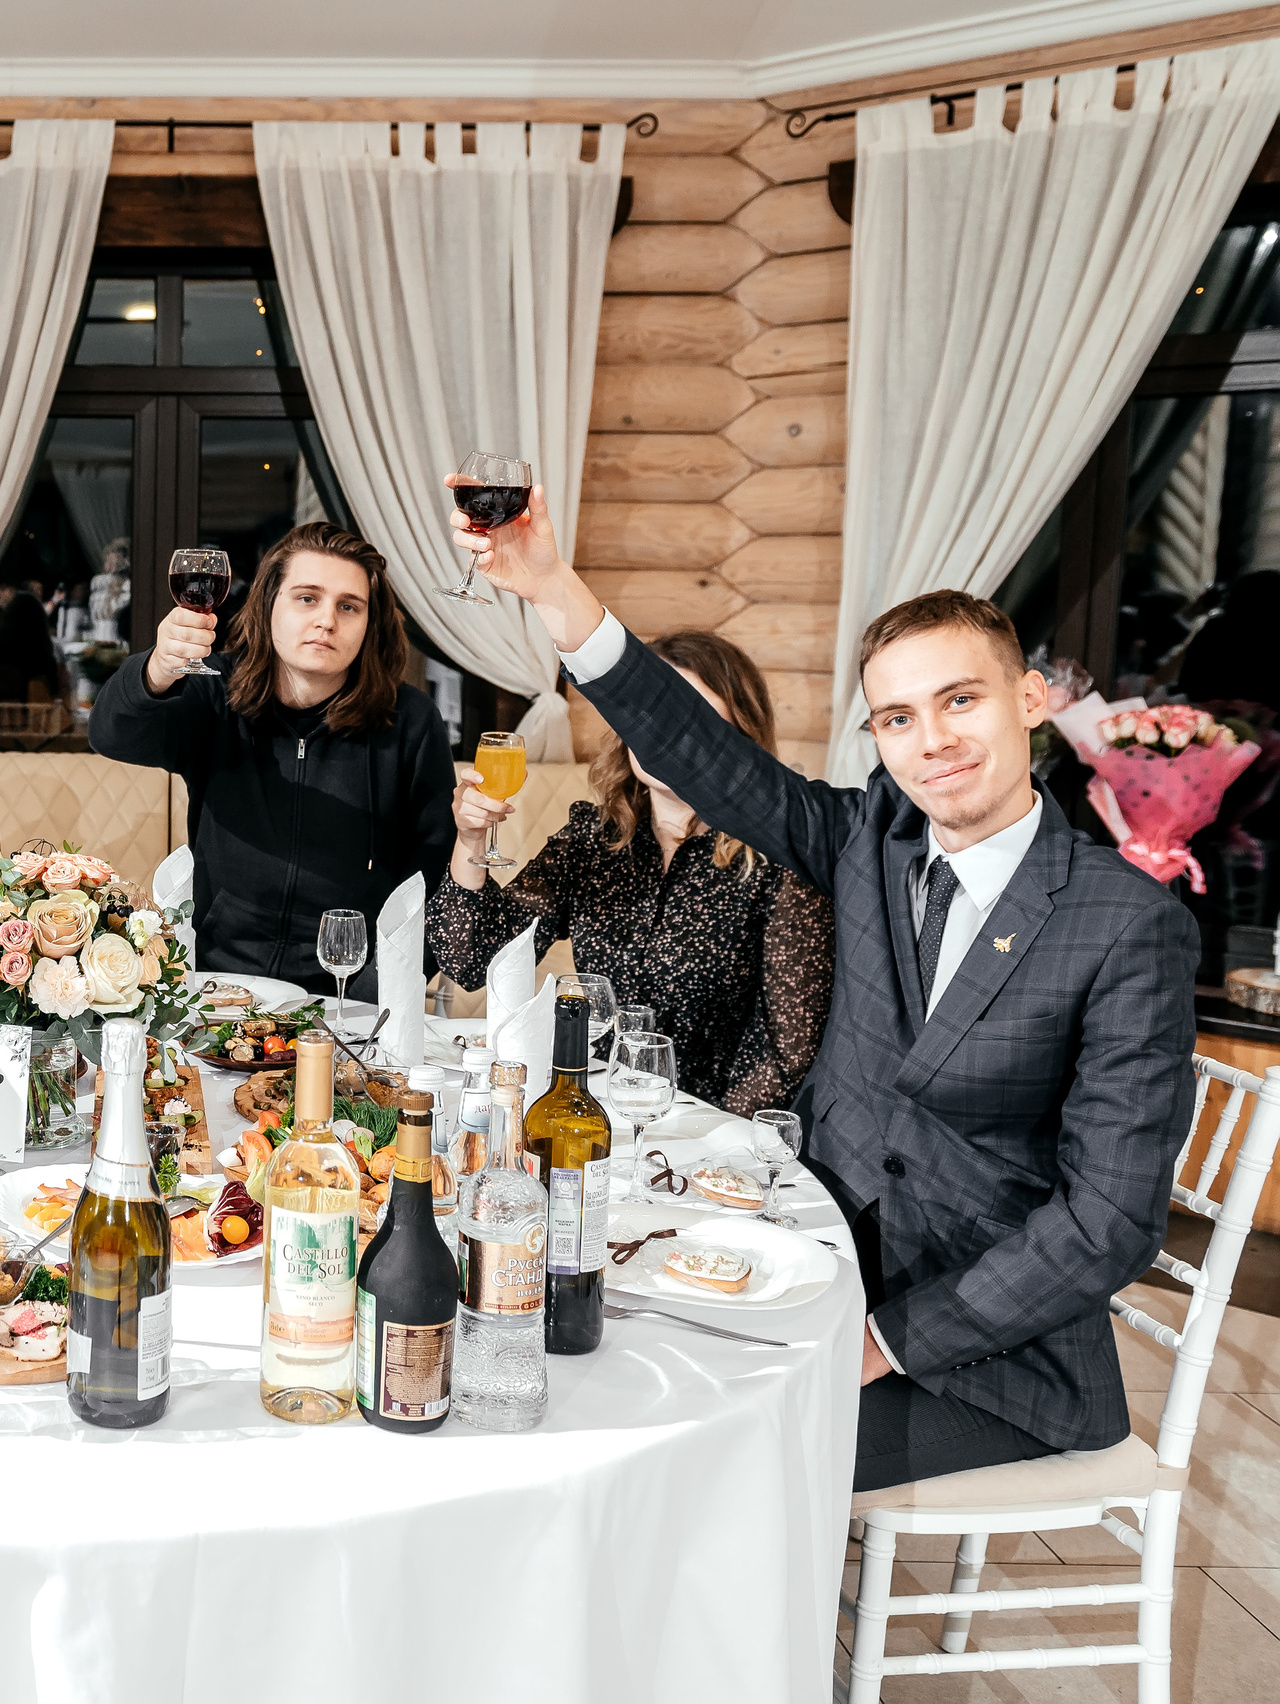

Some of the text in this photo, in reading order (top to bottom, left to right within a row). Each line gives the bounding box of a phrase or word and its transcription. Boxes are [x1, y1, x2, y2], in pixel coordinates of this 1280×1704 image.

[282, 1243, 349, 1261] CASTILLO
[287, 1262, 344, 1280] DEL SOL
[491, 1268, 543, 1288] СТАНД
